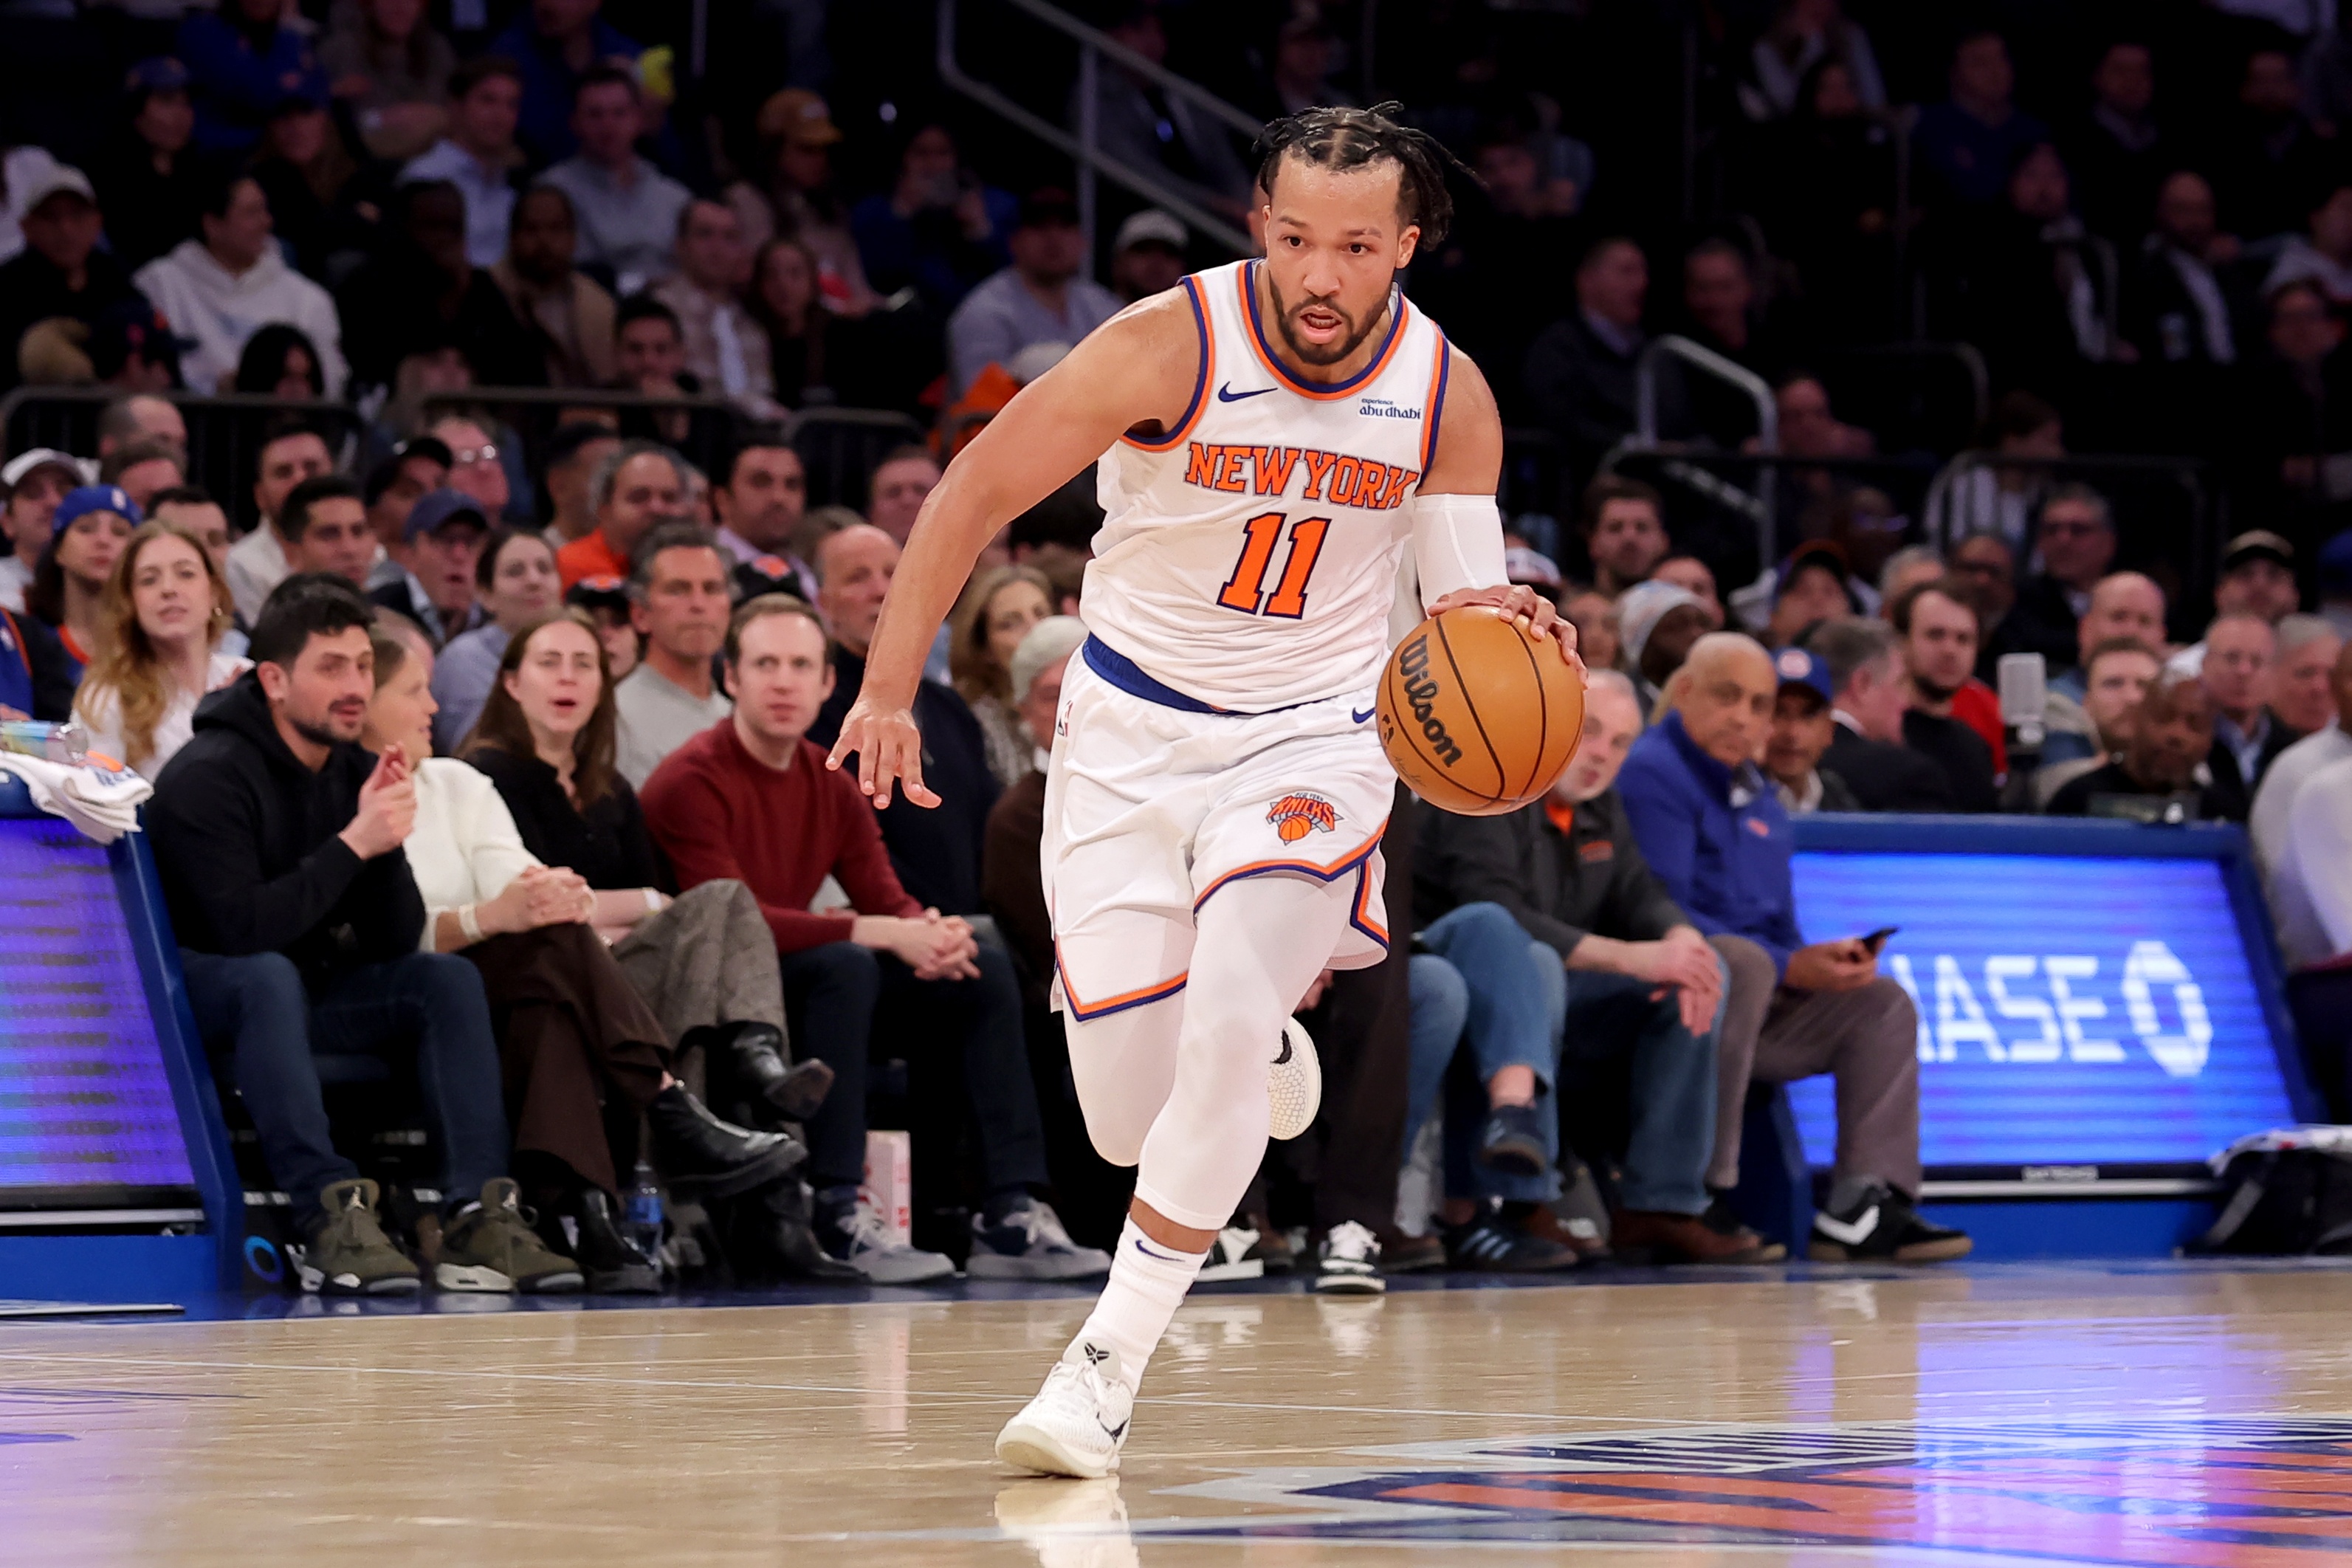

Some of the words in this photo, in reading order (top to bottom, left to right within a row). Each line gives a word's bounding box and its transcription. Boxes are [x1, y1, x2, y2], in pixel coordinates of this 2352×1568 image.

[1359, 405, 1383, 416] abu
[1385, 407, 1421, 419] dhabi
[1361, 398, 1394, 406] experience
[1183, 441, 1302, 498] NEW
[1302, 449, 1420, 510] YORK
[1216, 512, 1332, 619] 11
[1399, 633, 1463, 768] Wilson
[1266, 795, 1335, 831] KNICKS
